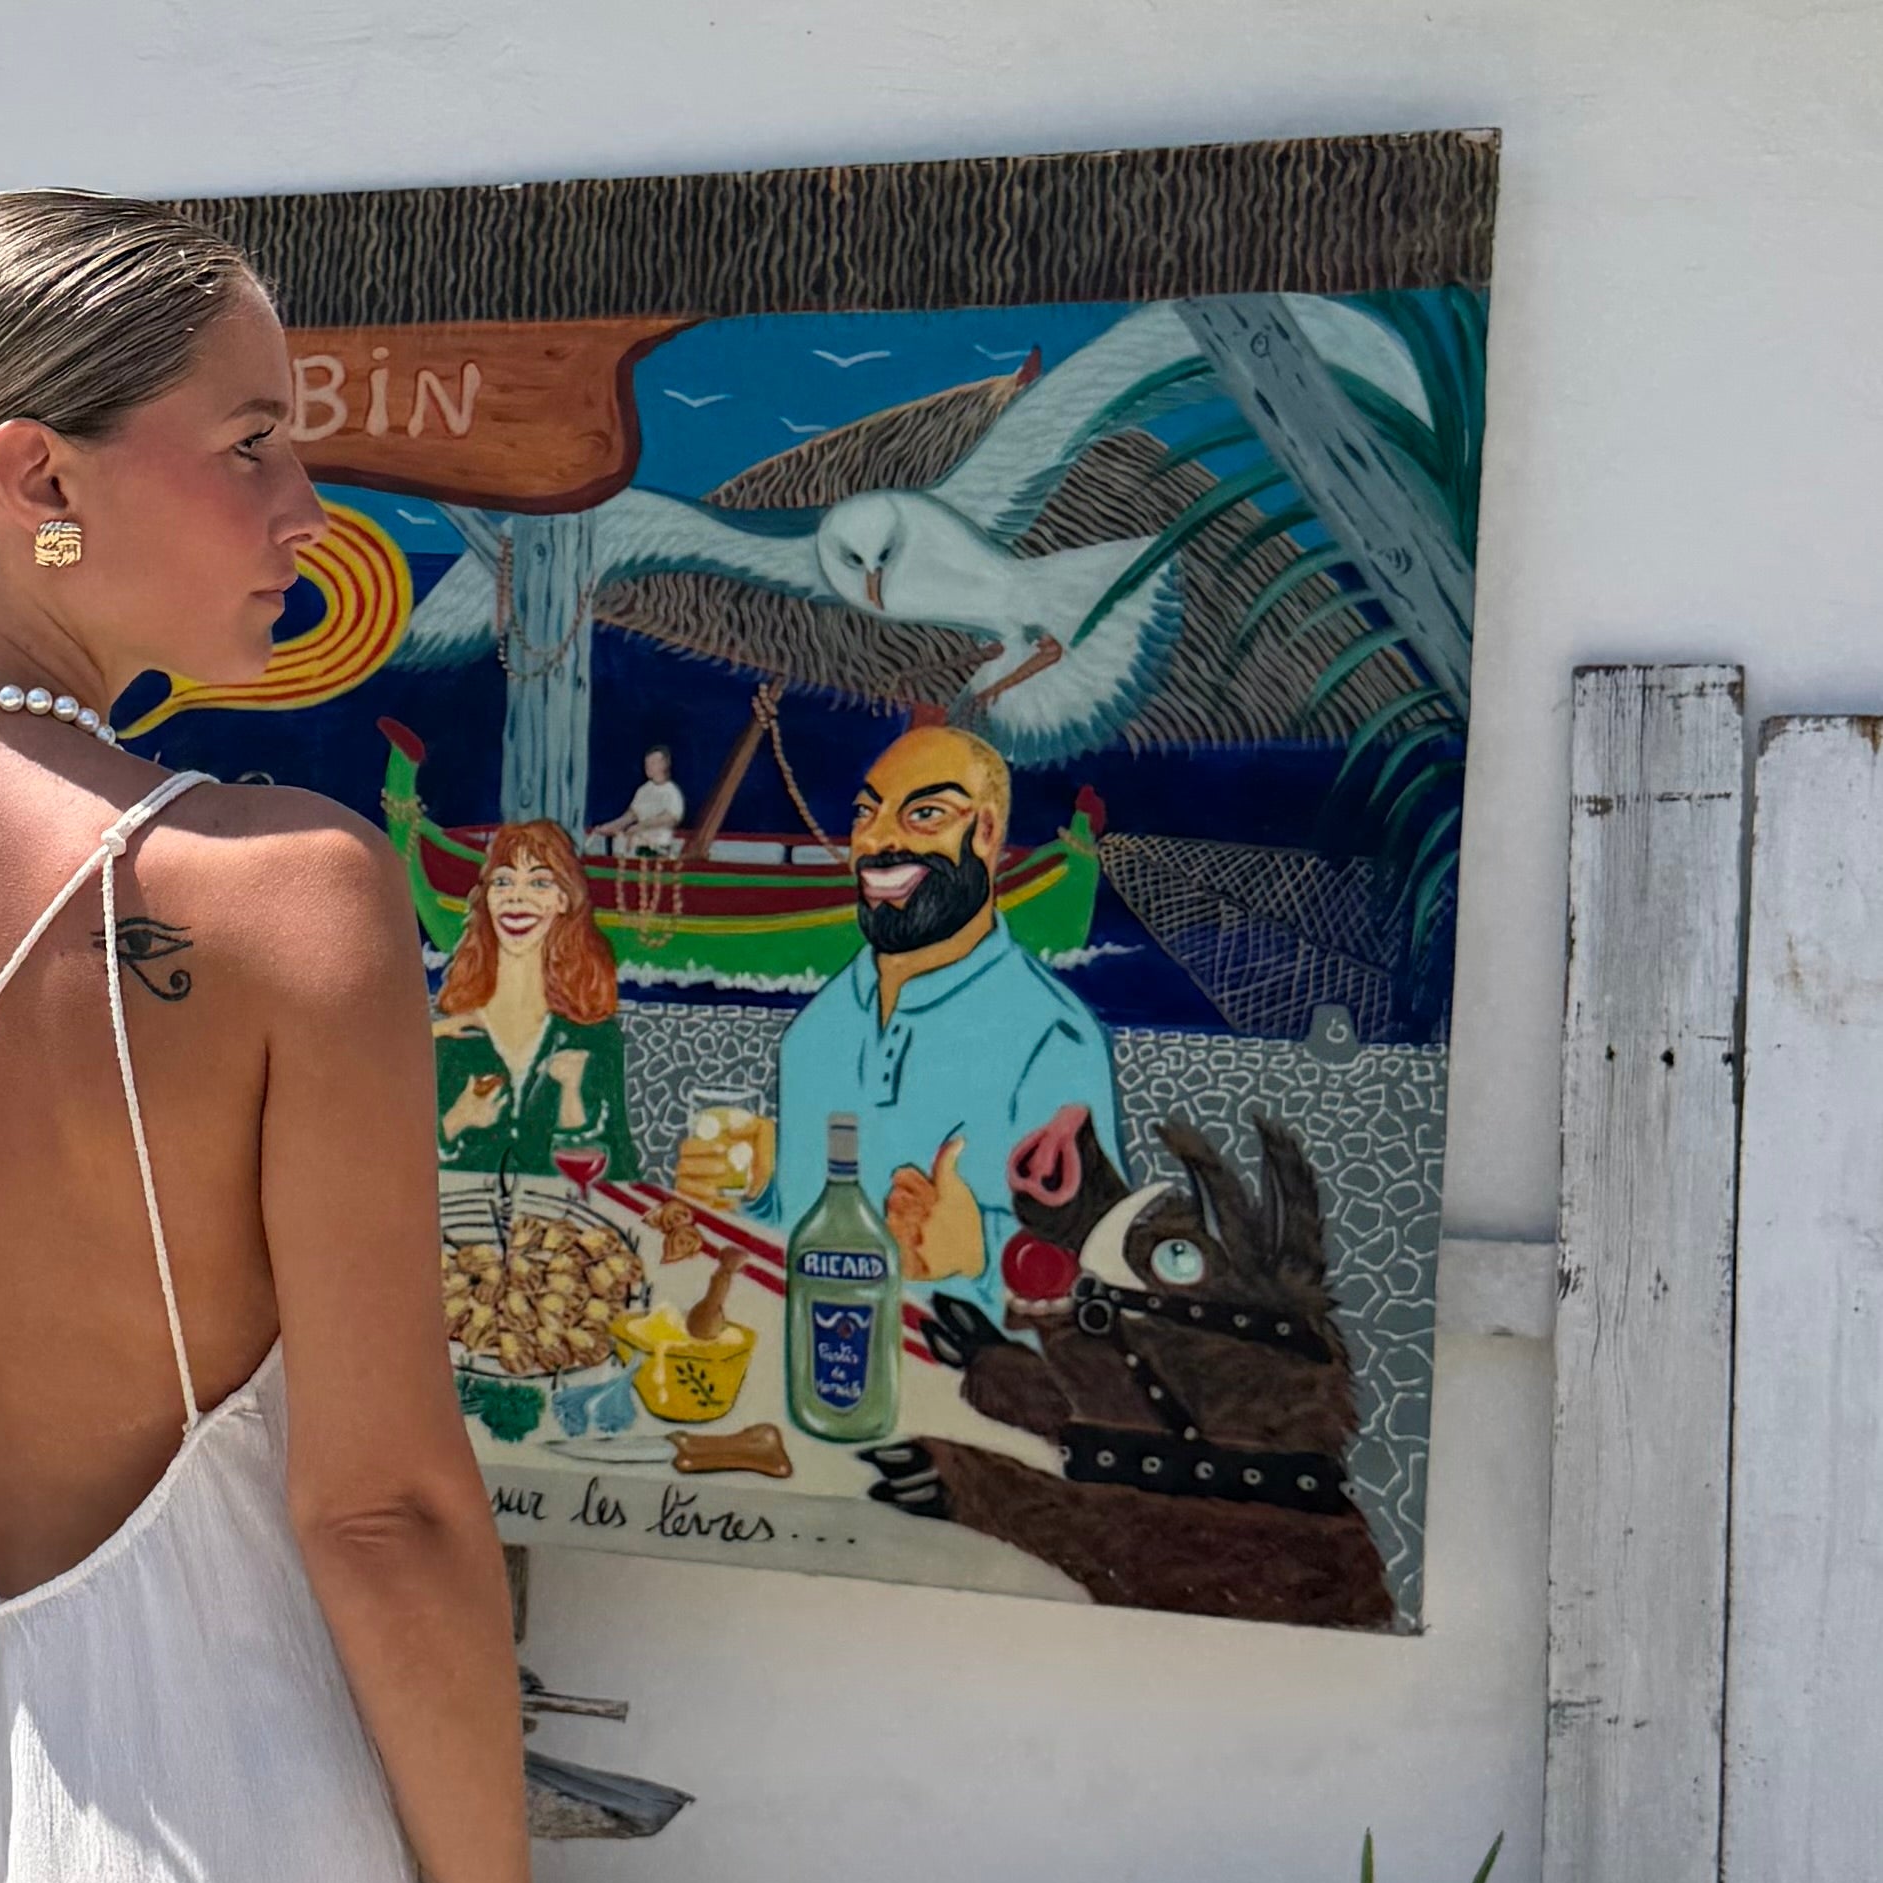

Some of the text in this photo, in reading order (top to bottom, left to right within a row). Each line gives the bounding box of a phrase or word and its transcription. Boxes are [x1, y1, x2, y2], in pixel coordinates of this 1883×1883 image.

[803, 1252, 884, 1278] RICARD
[491, 1486, 547, 1521] sur
[570, 1476, 627, 1528] les
